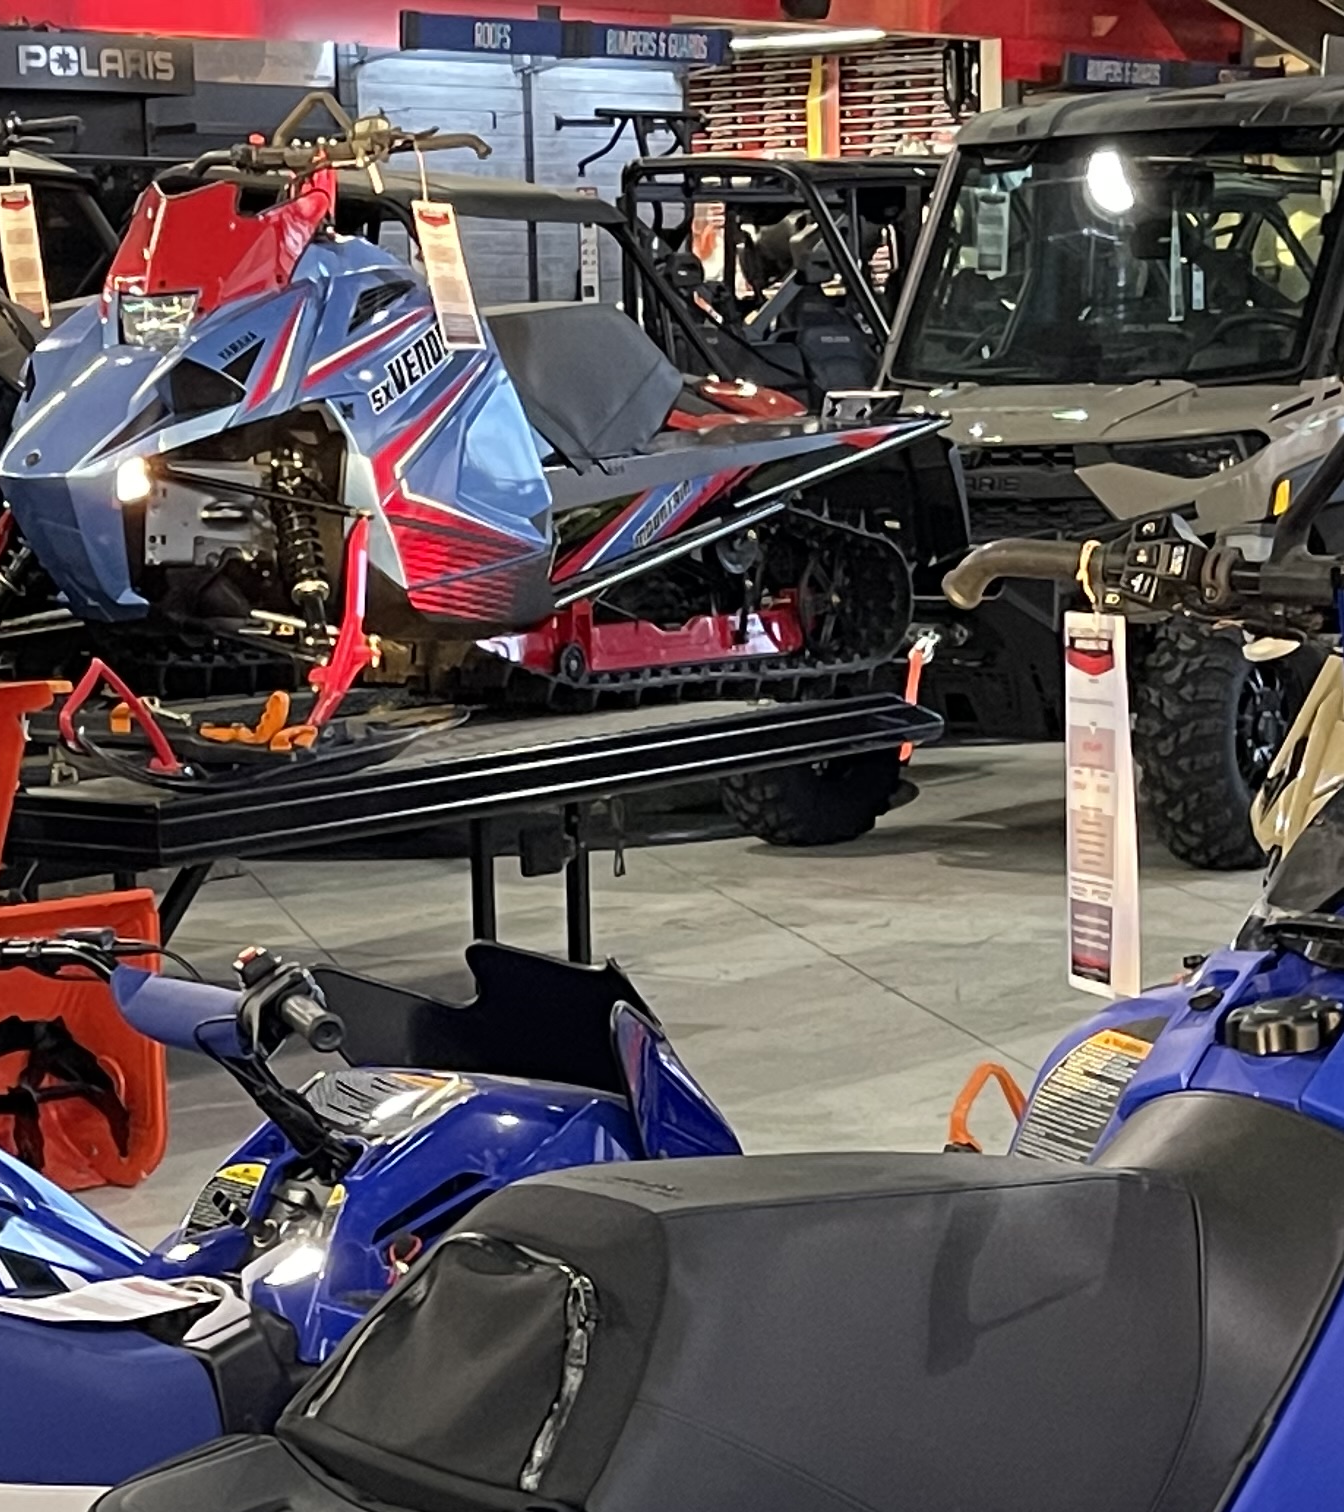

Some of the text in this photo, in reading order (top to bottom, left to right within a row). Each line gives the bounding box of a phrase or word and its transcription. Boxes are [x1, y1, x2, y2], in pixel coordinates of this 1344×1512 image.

[474, 21, 511, 49] ROOFS
[606, 28, 656, 56] BUMPERS
[668, 32, 708, 59] GUARDS
[18, 44, 175, 81] POLARIS
